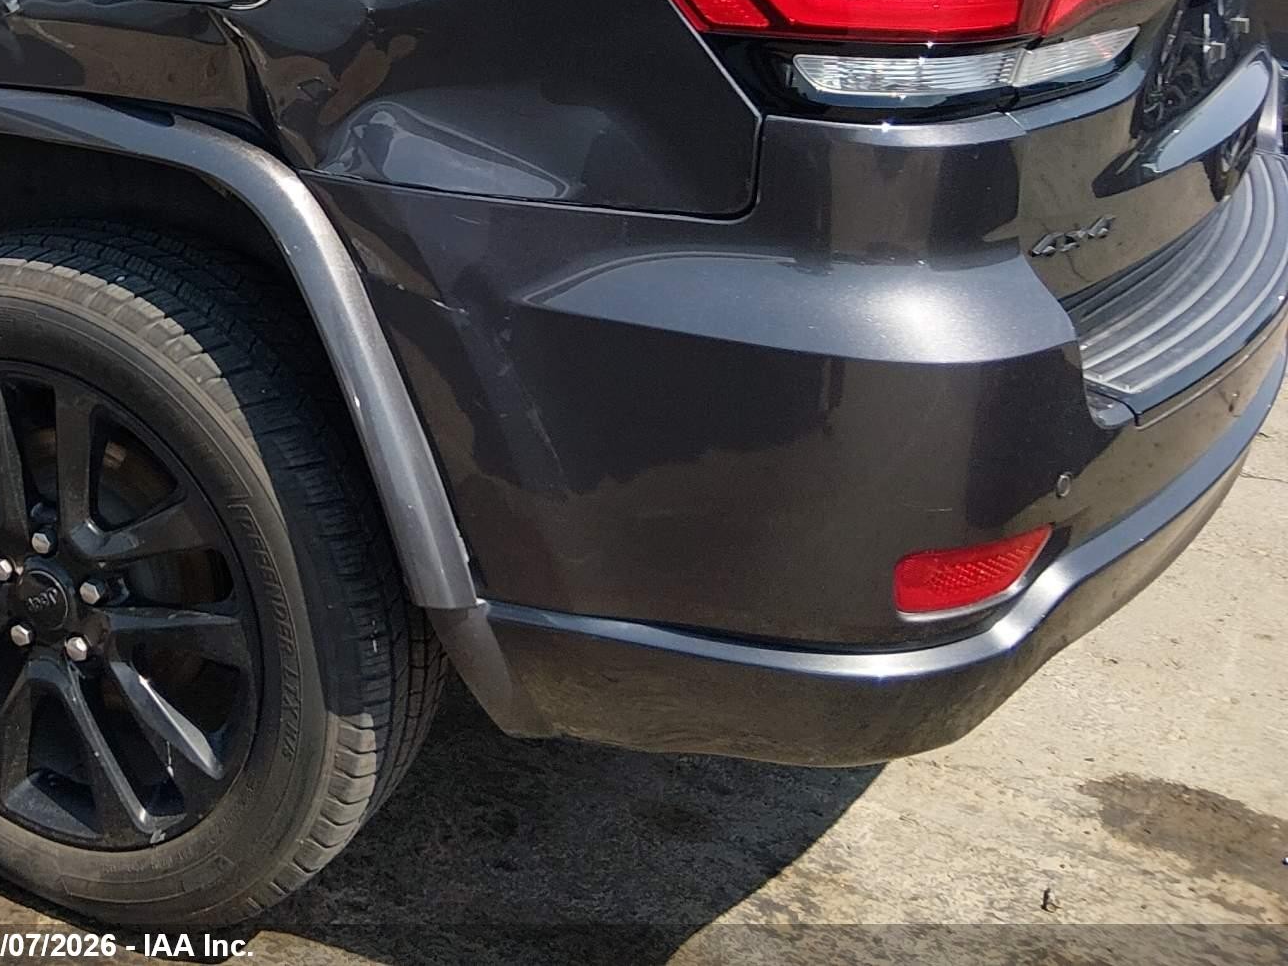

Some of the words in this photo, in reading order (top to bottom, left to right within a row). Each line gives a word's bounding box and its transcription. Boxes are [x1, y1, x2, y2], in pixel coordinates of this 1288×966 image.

[25, 586, 58, 612] Jeep
[239, 516, 294, 655] DEFENDER
[282, 665, 300, 719] LTX
